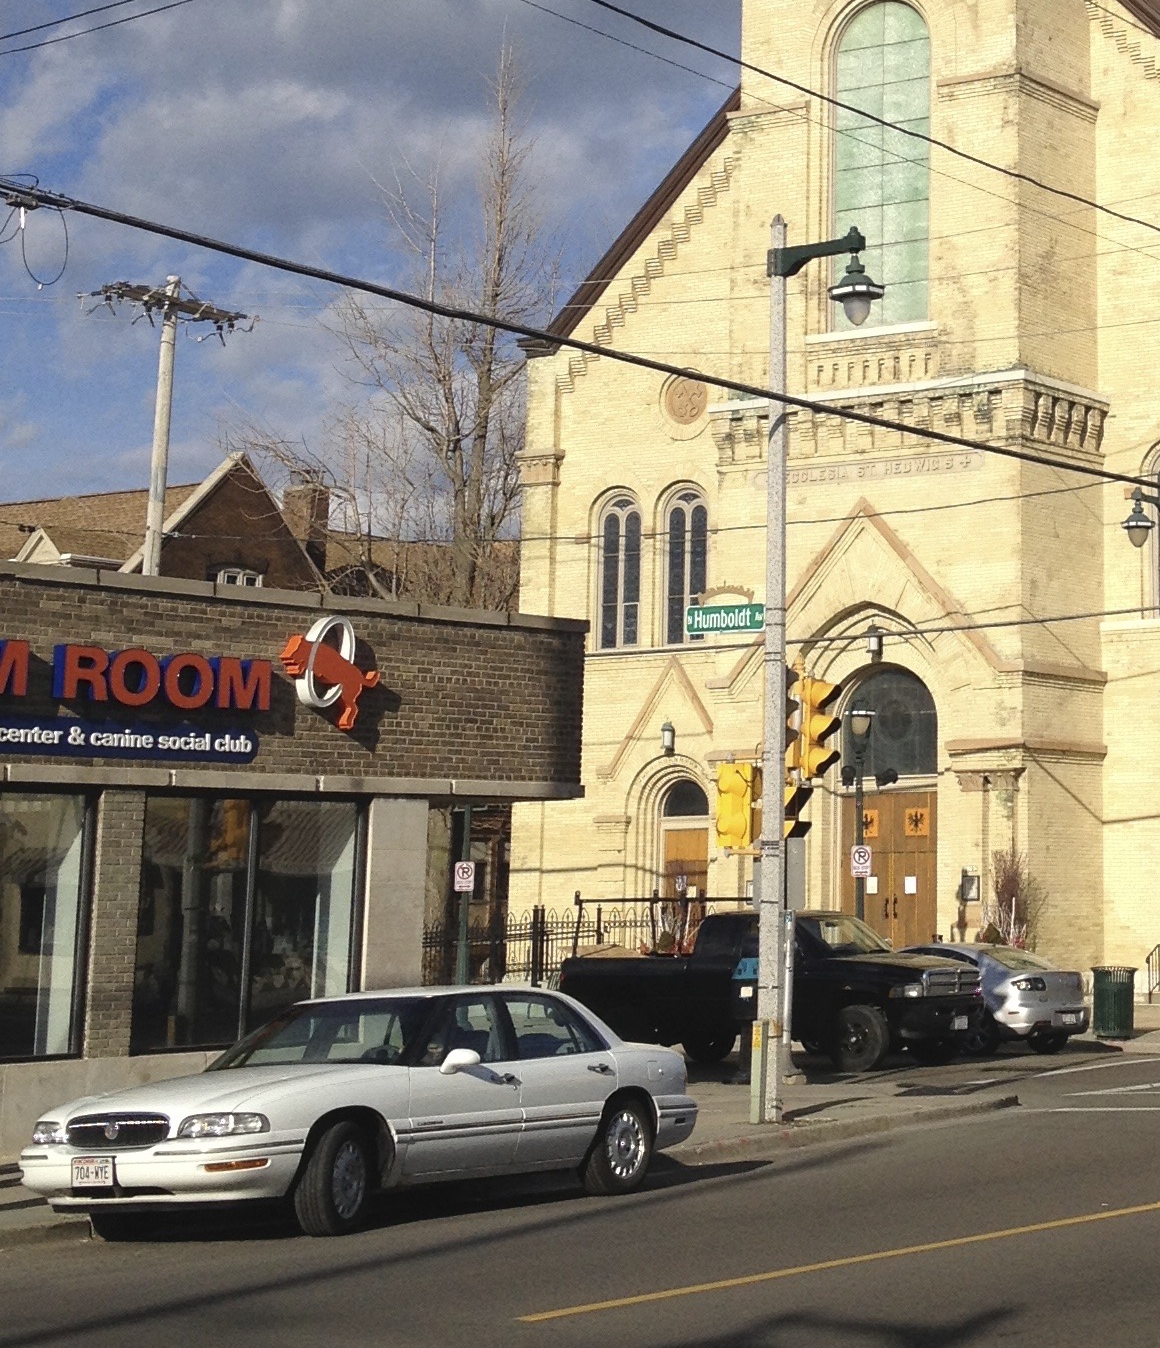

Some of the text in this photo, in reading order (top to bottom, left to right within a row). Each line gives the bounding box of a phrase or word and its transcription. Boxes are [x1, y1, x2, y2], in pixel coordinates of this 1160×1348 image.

[694, 607, 751, 629] Humboldt
[53, 643, 272, 711] ROOM
[0, 726, 253, 753] center & canine social club
